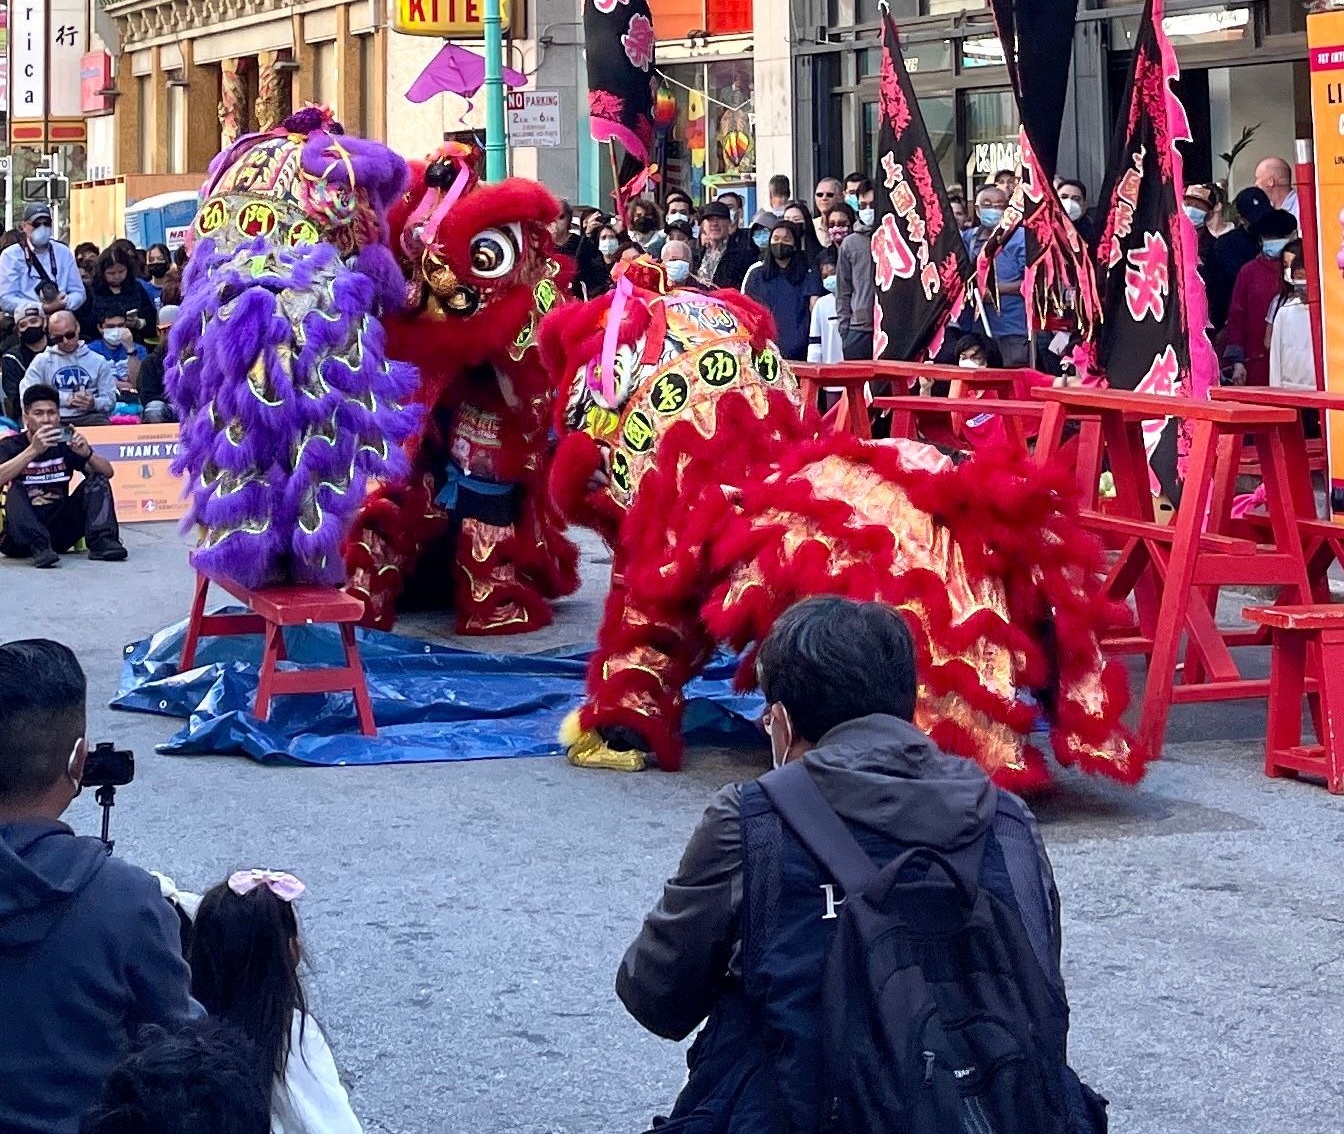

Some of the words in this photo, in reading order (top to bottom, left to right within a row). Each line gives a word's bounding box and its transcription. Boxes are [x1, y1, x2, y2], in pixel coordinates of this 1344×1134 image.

[508, 93, 523, 108] NO
[526, 95, 558, 106] PARKING
[119, 445, 160, 458] THANK
